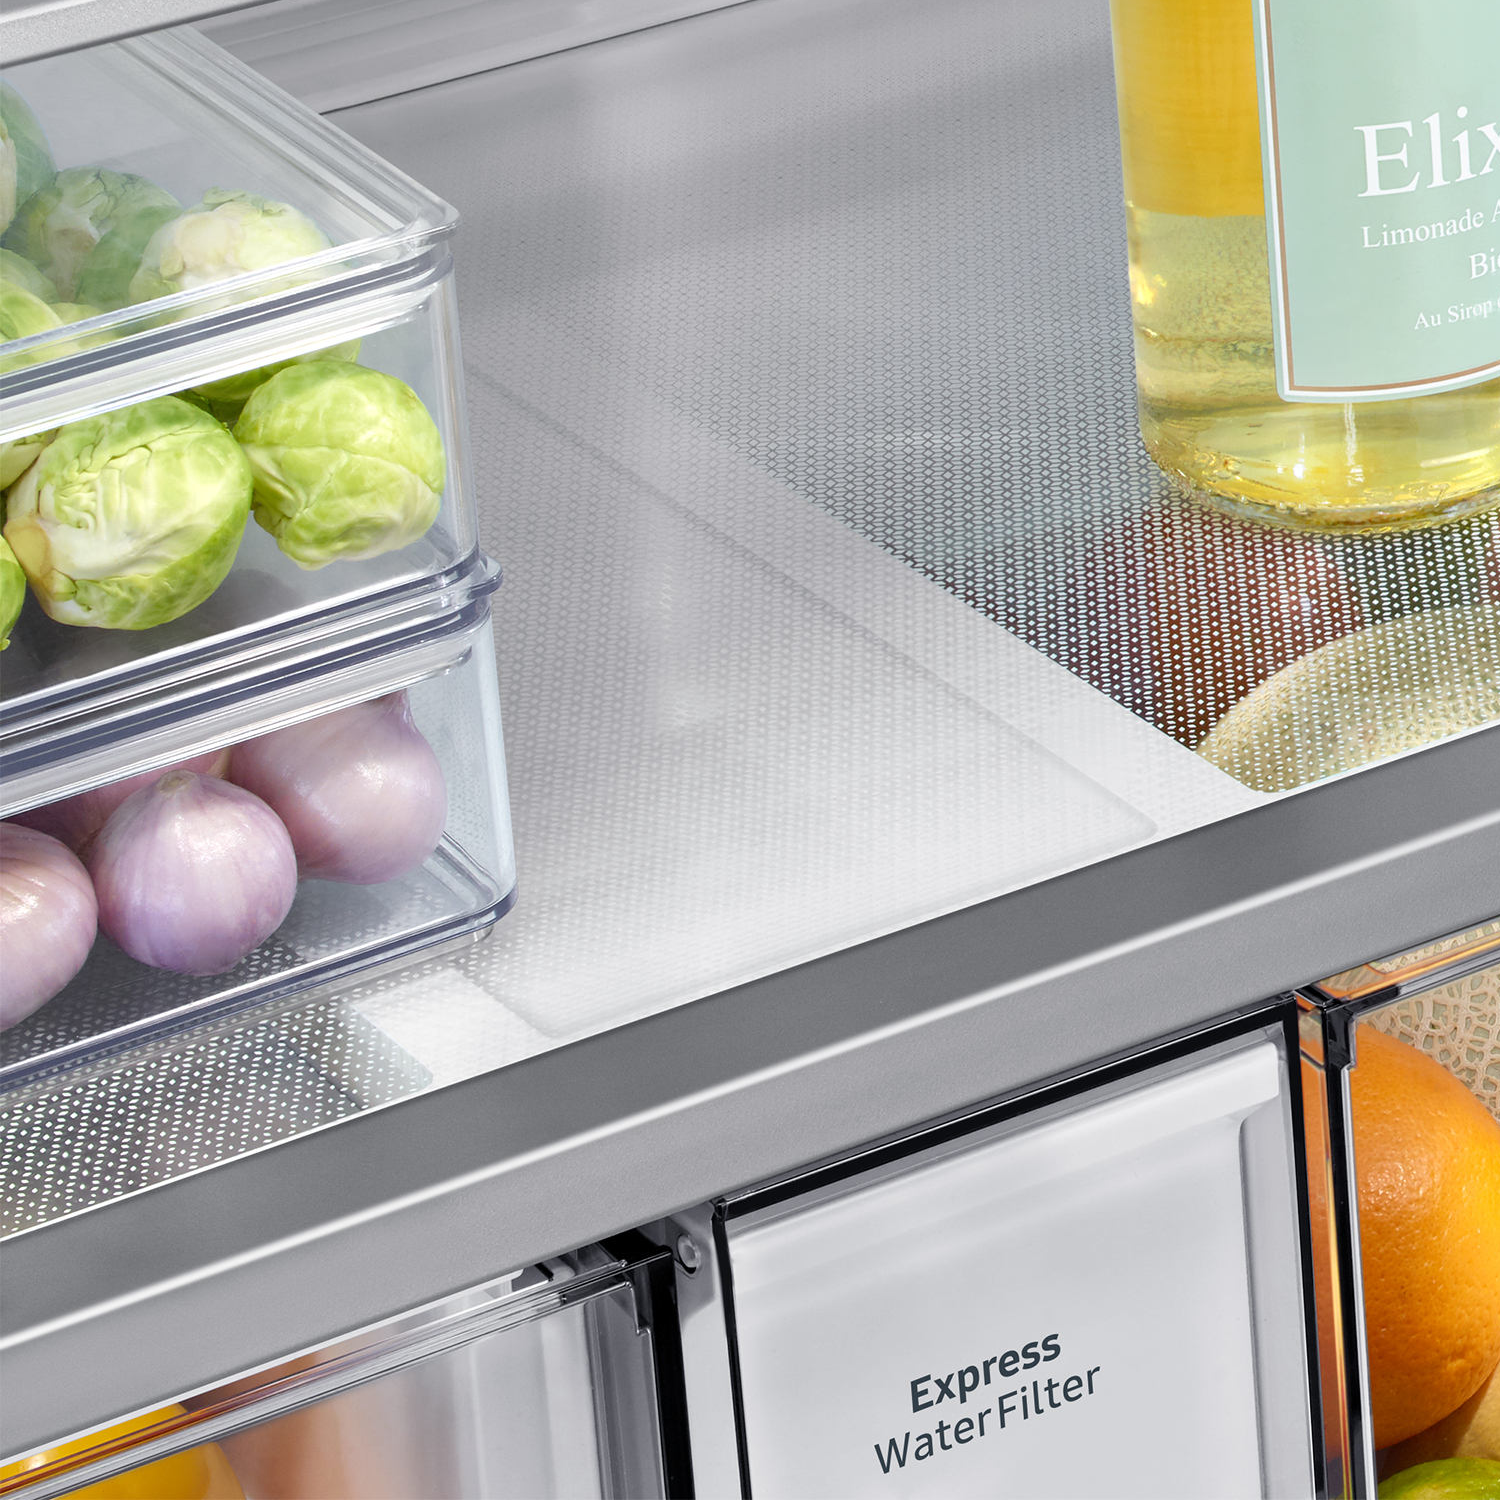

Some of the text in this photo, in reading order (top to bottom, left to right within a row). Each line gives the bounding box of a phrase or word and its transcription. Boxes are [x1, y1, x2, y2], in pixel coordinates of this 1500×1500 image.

[1360, 206, 1485, 249] Limonade
[1412, 311, 1443, 331] Au
[1447, 299, 1494, 324] Sirop
[910, 1333, 1062, 1414] Express
